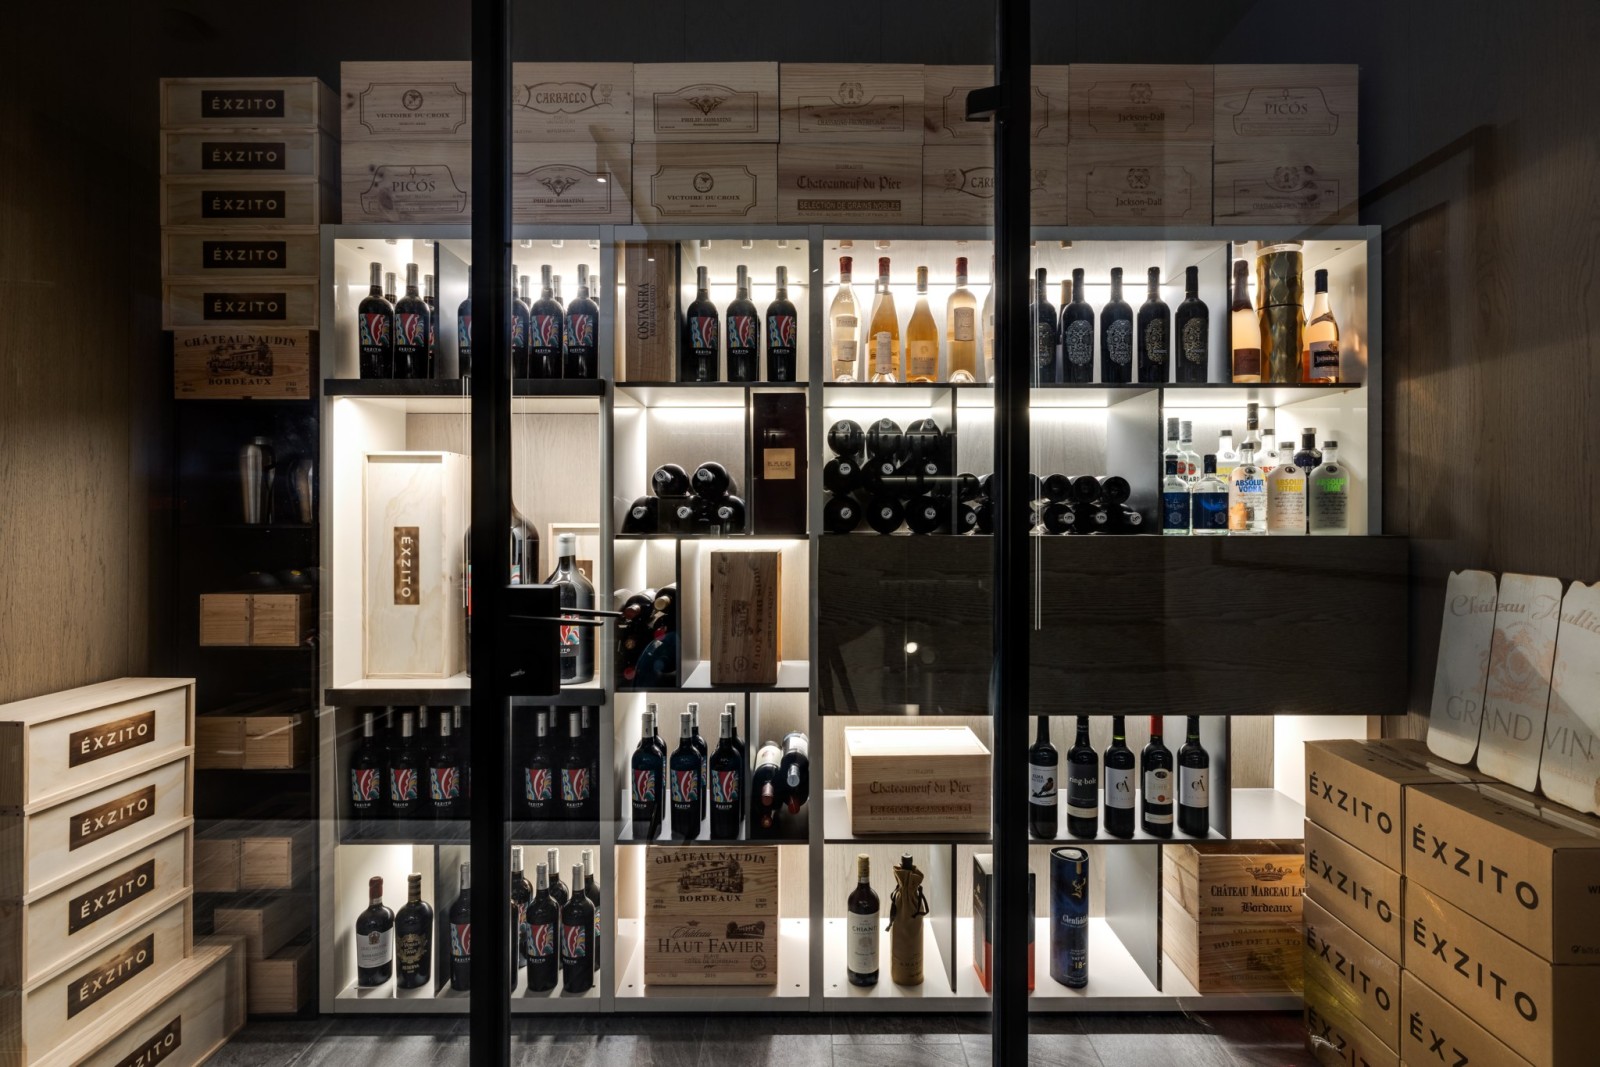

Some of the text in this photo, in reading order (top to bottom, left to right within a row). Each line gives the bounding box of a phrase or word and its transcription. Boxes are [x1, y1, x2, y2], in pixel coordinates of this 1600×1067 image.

[212, 97, 276, 110] ÉXZITO
[535, 92, 587, 104] CARBALLO
[212, 149, 277, 163] ÉXZITO
[392, 178, 436, 193] PICÓS
[863, 176, 876, 190] du
[212, 198, 277, 211] ÉXZITO
[799, 201, 836, 209] SELECTION
[873, 202, 900, 210] NOBLES
[213, 247, 278, 261] ÉXZITO
[214, 299, 278, 312] ÉXZITO
[637, 283, 649, 340] COSTASERA
[184, 334, 297, 348] CHÂTEAU NAUDIN
[208, 377, 272, 386] BORDEAUX
[1236, 479, 1264, 487] ABSOLUT
[401, 536, 414, 598] ÉXZITO
[81, 722, 148, 755] ÉXZITO
[934, 781, 946, 793] du
[1309, 770, 1393, 835] ÉXZITO
[81, 798, 148, 837] ÉXZITO
[655, 852, 767, 865] CHÂTEAU NAUDIN
[1413, 822, 1539, 911] ÉXZITO
[1211, 884, 1249, 897] CHÂTEAU
[1251, 885, 1289, 897] MARCEAU
[1309, 850, 1392, 923] ÉXZITO
[80, 873, 148, 919] ÉXZITO
[679, 894, 741, 902] BORDEAUX
[1241, 901, 1293, 913] Bordeaux
[657, 938, 765, 953] HAUT FAVIER
[1306, 926, 1391, 1011] ÉXZITO
[1413, 917, 1538, 1022] ÉXZITO
[79, 950, 147, 1002] ÉXZITO
[1409, 1011, 1469, 1067] ÉXZ
[129, 1033, 174, 1067] ZITO
